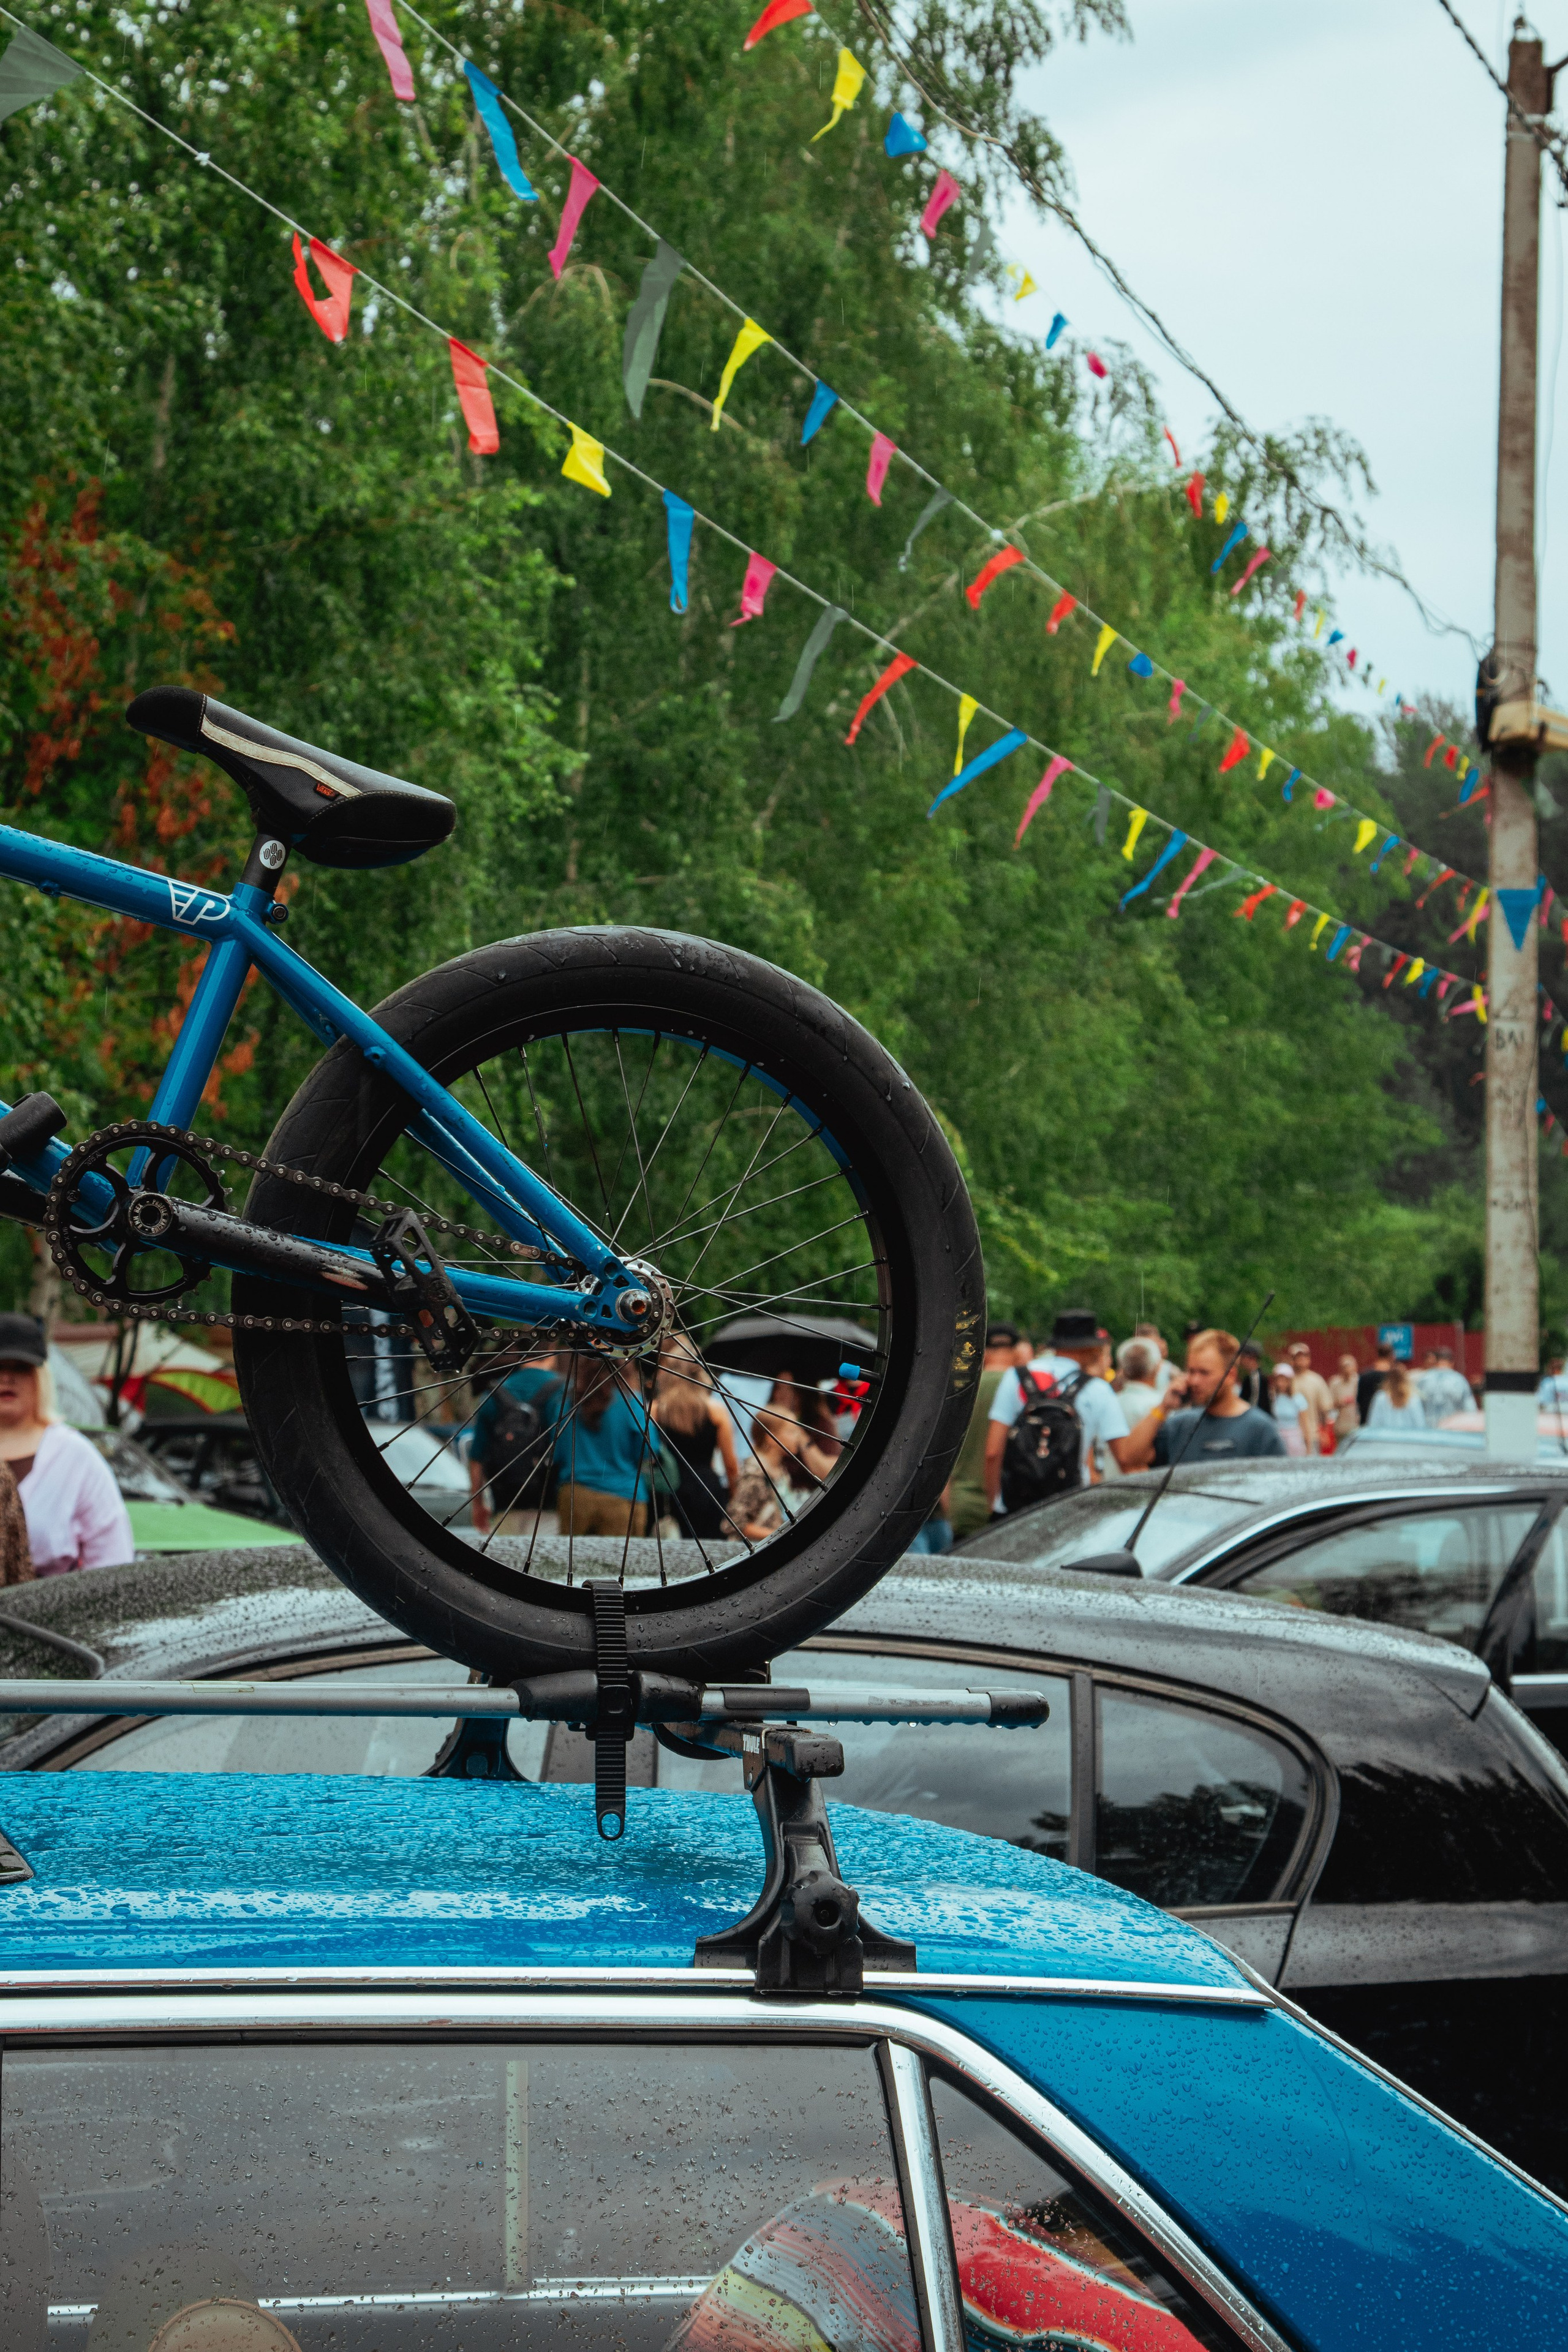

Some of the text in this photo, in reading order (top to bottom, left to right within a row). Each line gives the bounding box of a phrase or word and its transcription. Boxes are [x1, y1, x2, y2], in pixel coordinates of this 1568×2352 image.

[316, 783, 333, 796] VANS
[134, 1203, 143, 1213] HEX
[151, 1199, 168, 1234] PROFILE RACING
[743, 1734, 760, 1754] THULE
